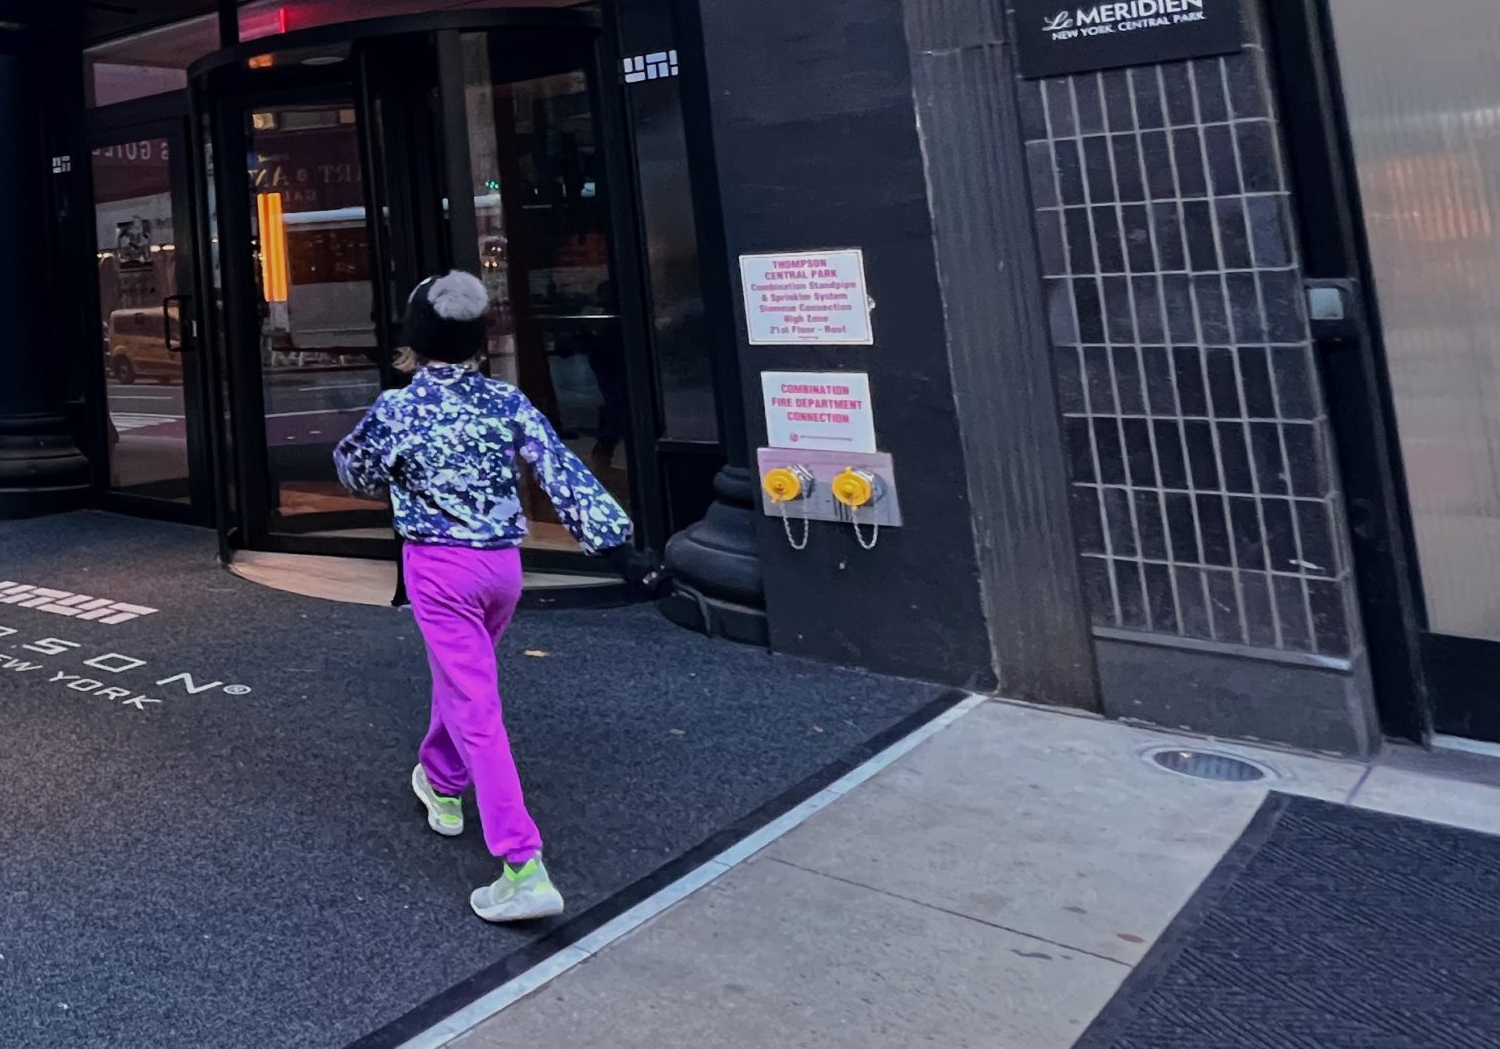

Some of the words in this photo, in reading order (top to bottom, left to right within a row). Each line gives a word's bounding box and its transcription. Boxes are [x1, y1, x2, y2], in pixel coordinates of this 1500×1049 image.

[1042, 11, 1073, 31] Le
[1052, 29, 1079, 40] NEW
[1118, 16, 1171, 32] CENTRAL
[1174, 11, 1206, 24] PARK
[772, 259, 827, 269] THOMPSON
[765, 271, 807, 280] CENTRAL
[811, 269, 838, 279] PARK
[781, 384, 849, 395] COMBINATION
[772, 397, 792, 407] FIRE
[796, 398, 862, 410] DEPARTMENT
[787, 412, 850, 424] CONNECTION
[49, 671, 163, 710] YORK
